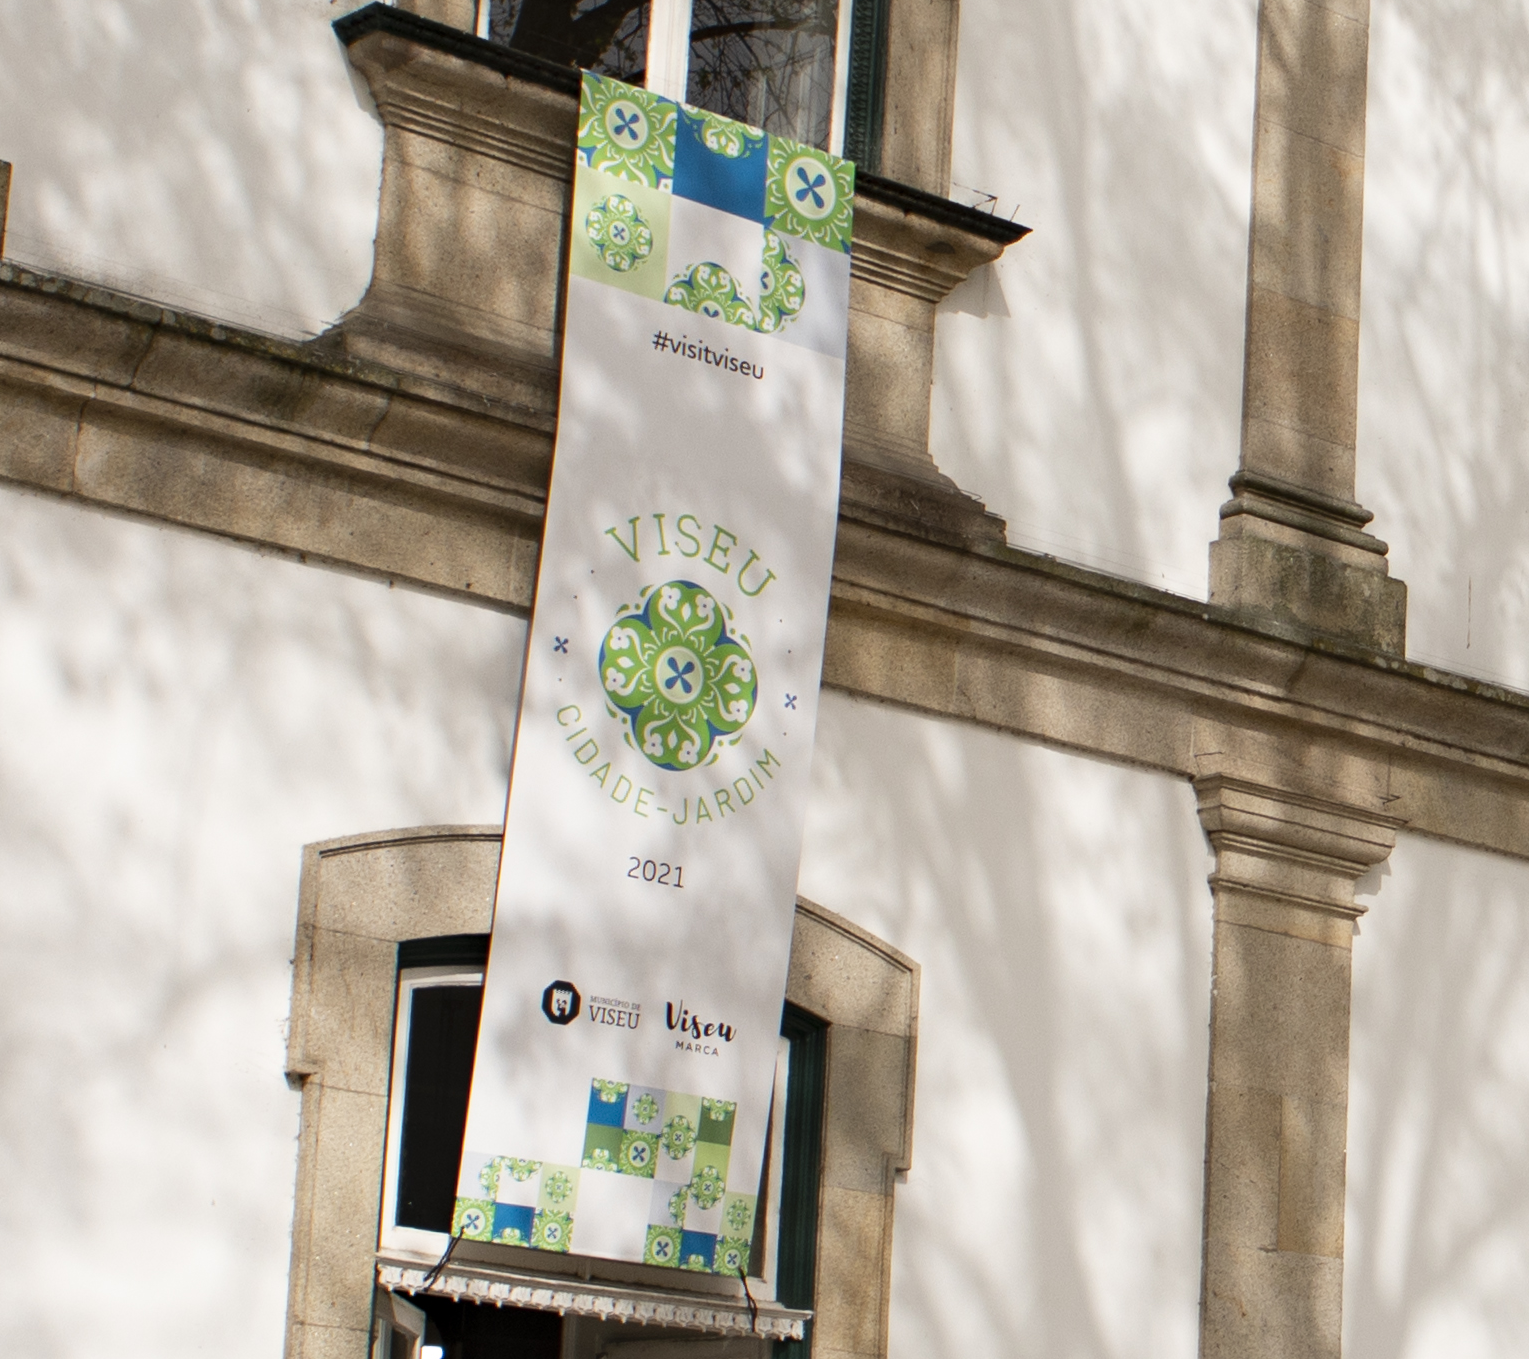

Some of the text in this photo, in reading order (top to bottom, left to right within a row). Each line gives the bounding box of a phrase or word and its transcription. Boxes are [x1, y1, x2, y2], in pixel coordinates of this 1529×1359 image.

[652, 330, 765, 381] #visitviseu
[605, 513, 777, 598] VISEU
[556, 703, 781, 825] CIDADE-JARDIM
[627, 856, 685, 889] 2021
[589, 1005, 640, 1029] VISEU
[665, 999, 736, 1042] Viseu
[675, 1041, 719, 1057] MARCA
